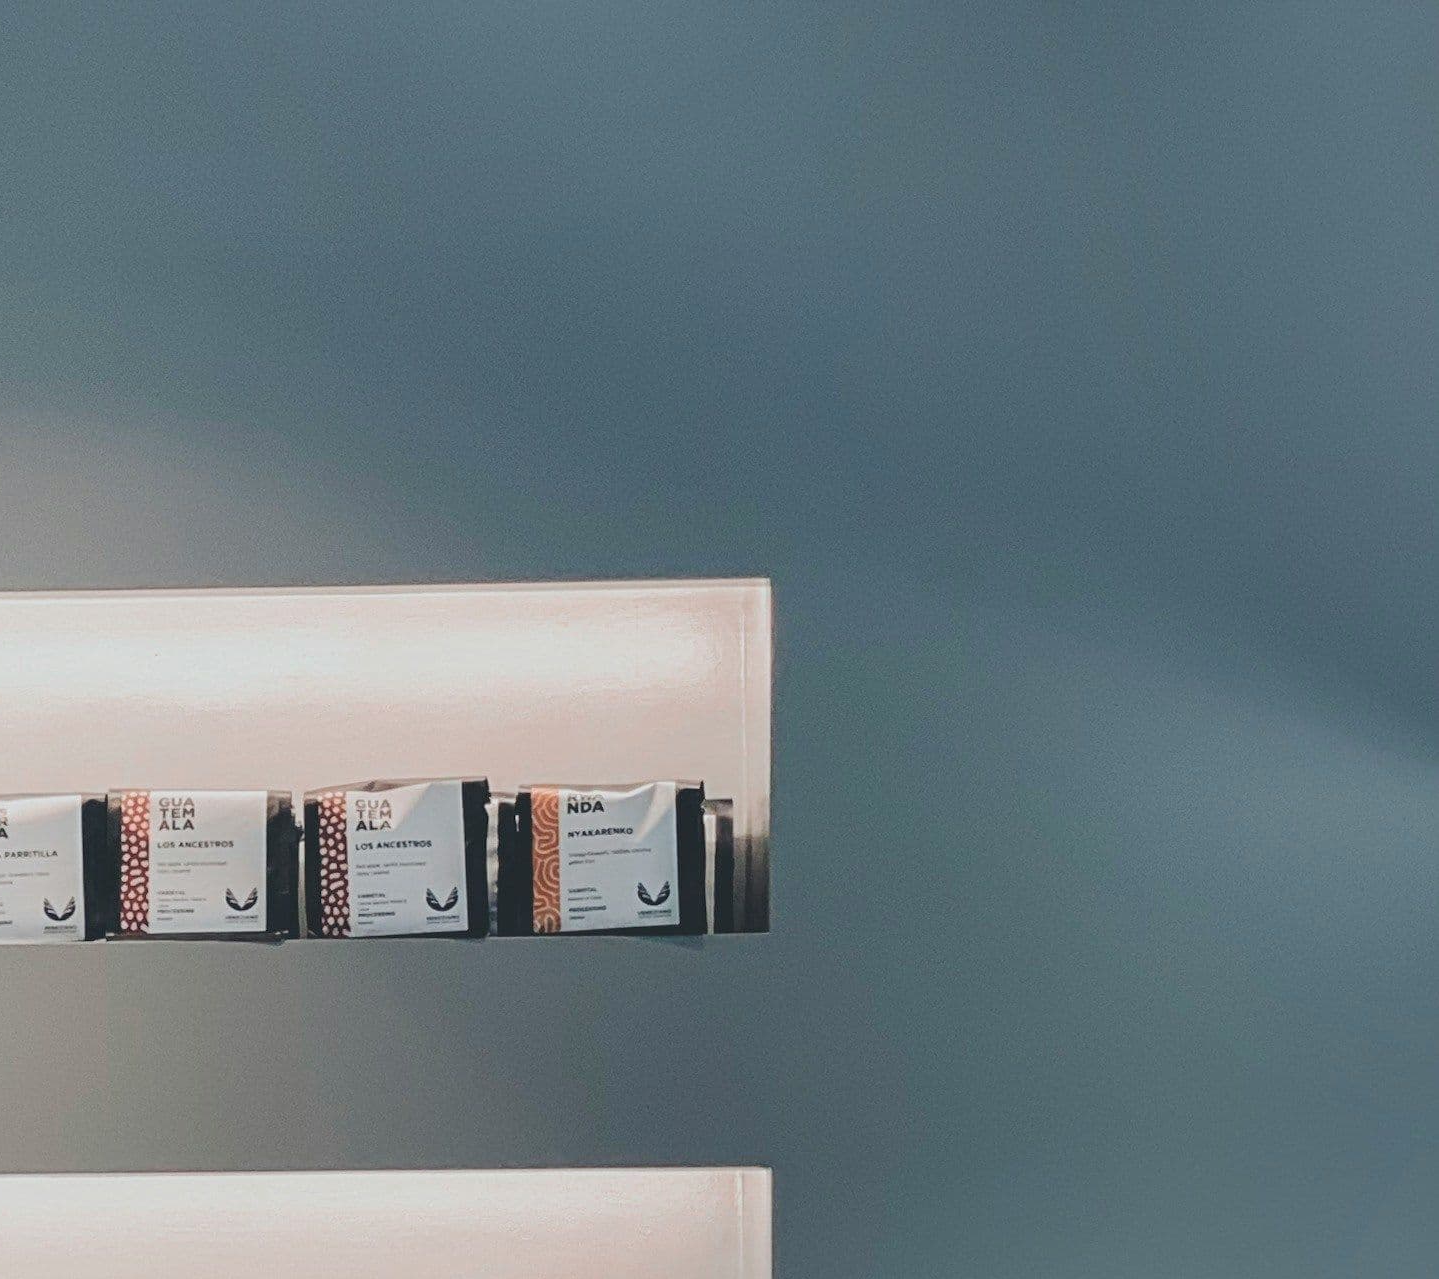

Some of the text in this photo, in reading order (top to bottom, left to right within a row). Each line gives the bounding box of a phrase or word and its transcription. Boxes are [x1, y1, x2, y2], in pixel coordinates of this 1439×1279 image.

[159, 798, 194, 807] GUA
[355, 800, 391, 809] GUA
[567, 801, 604, 814] NDA
[160, 808, 195, 818] TEM
[358, 810, 392, 819] TEM
[159, 820, 195, 831] ALA
[356, 820, 391, 831] ALA
[355, 843, 373, 851] LOS
